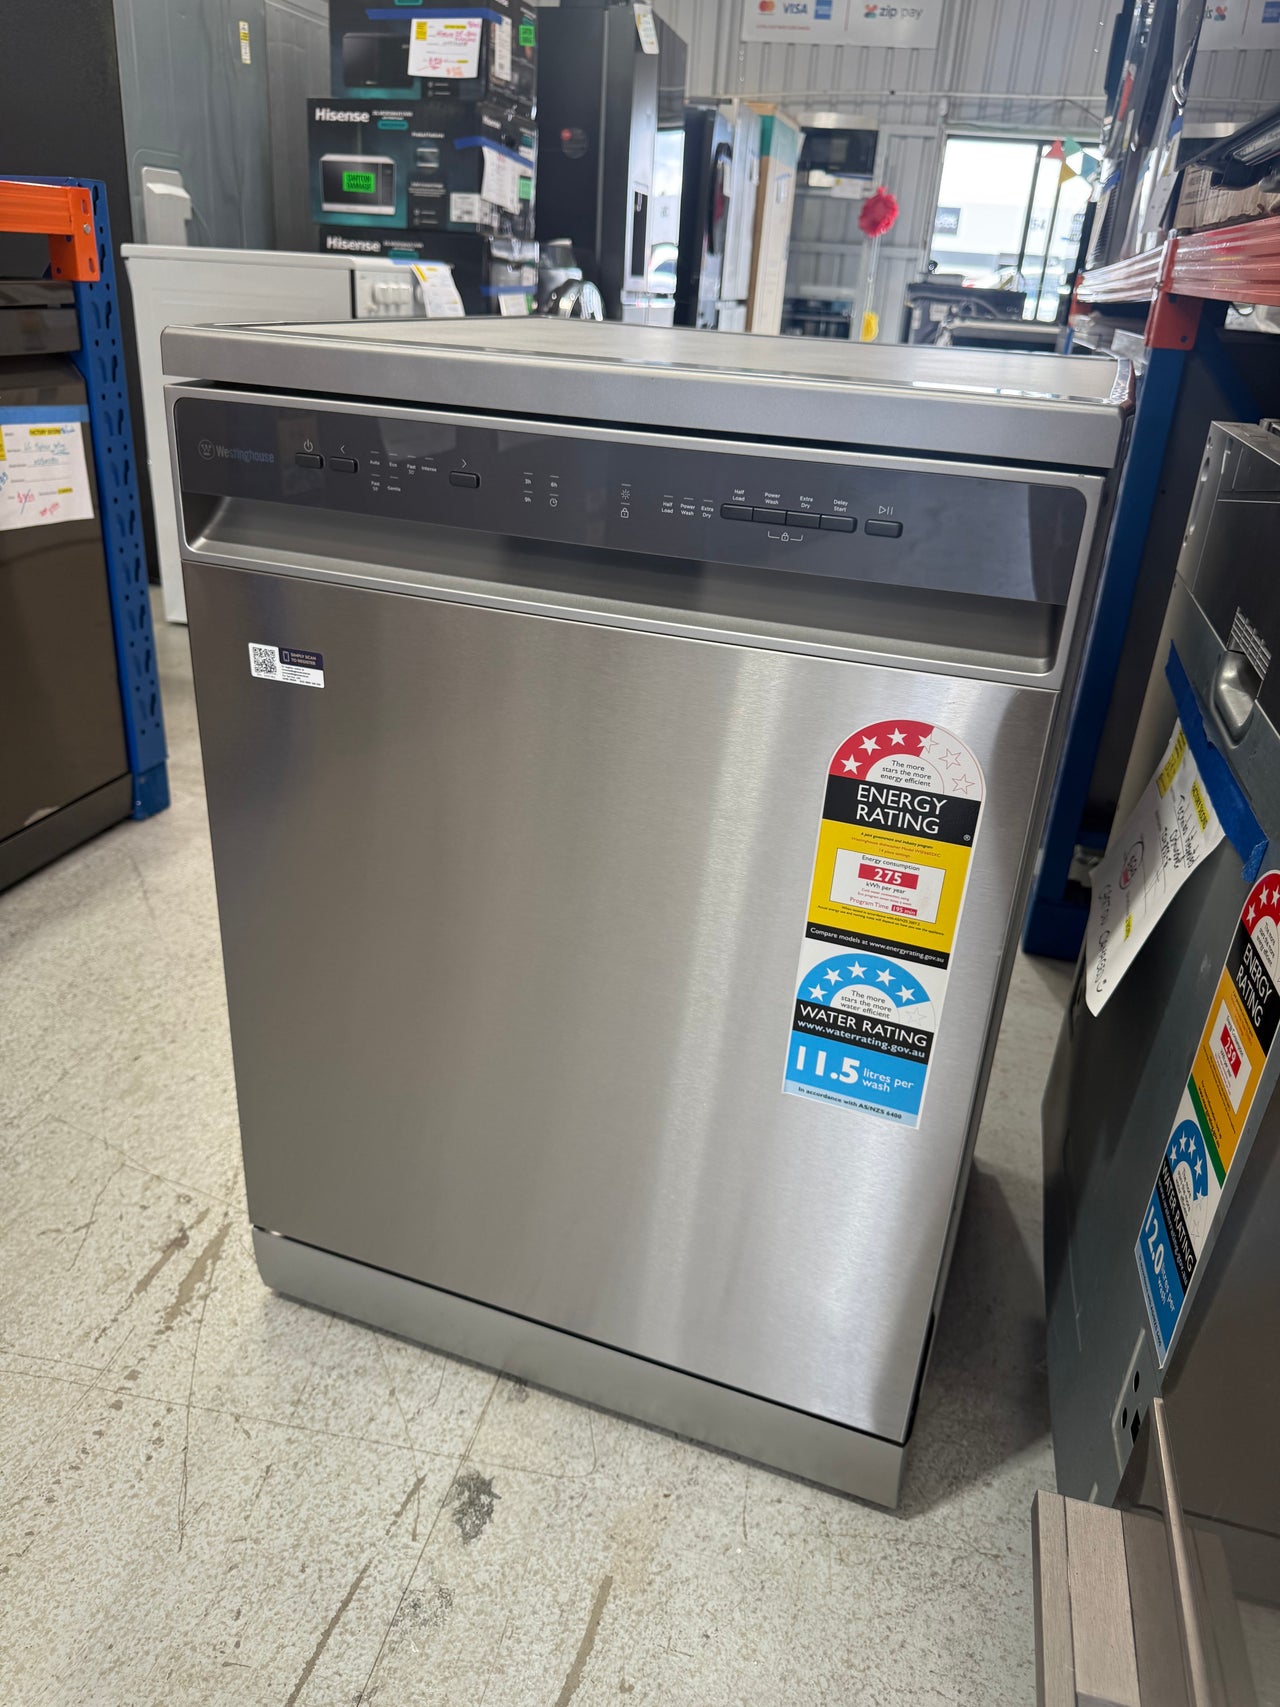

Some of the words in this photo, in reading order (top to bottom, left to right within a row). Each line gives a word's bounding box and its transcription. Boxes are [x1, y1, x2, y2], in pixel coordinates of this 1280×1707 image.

[782, 3, 808, 15] VISA
[879, 5, 897, 19] zip
[901, 7, 923, 20] pay
[315, 108, 370, 123] Hisense
[326, 236, 381, 252] Hisense
[216, 445, 274, 463] Westinghouse
[833, 499, 849, 507] Delay
[882, 766, 898, 775] stars
[900, 769, 911, 777] the
[912, 772, 932, 780] more
[892, 759, 905, 768] The
[906, 763, 925, 771] more
[880, 774, 903, 783] energy
[904, 776, 931, 787] efficient
[857, 784, 948, 815] ENERGY
[856, 804, 940, 834] RATING
[861, 855, 881, 865] Energy
[883, 859, 920, 871] consumption
[874, 868, 902, 884] 275
[865, 882, 880, 890] kWh
[892, 887, 906, 895] year
[850, 897, 874, 908] Program
[875, 901, 889, 910] Time
[893, 905, 903, 913] 195
[904, 907, 916, 915] min
[810, 927, 838, 939] Compare
[839, 933, 860, 944] models
[869, 941, 945, 963] www.energyrating.gov.au
[1243, 942, 1272, 1004] ENERGY
[841, 995, 858, 1004] stars
[859, 998, 871, 1007] the
[873, 1003, 892, 1012] more
[851, 990, 865, 999] The
[867, 994, 886, 1004] more
[1236, 964, 1264, 1028] RATING
[840, 1002, 860, 1012] water
[862, 1006, 890, 1019] efficient
[800, 1004, 857, 1030] WATER
[862, 1020, 928, 1047] RATING
[797, 1019, 926, 1058] www.waterrating.gov.au
[1225, 1036, 1237, 1066] 259
[796, 1045, 861, 1085] 11.5
[863, 1067, 891, 1083] litres
[893, 1077, 914, 1089] per
[862, 1079, 890, 1093] wash
[806, 1089, 842, 1103] accordance
[843, 1099, 858, 1108] with
[858, 1103, 885, 1115] AS/NZS
[886, 1110, 902, 1120] 6400
[1162, 1161, 1178, 1216] WATER
[1175, 1211, 1193, 1273] RATING
[1145, 1206, 1165, 1275] 12.0
[1166, 1291, 1176, 1312] per
[1158, 1276, 1166, 1306] wash
